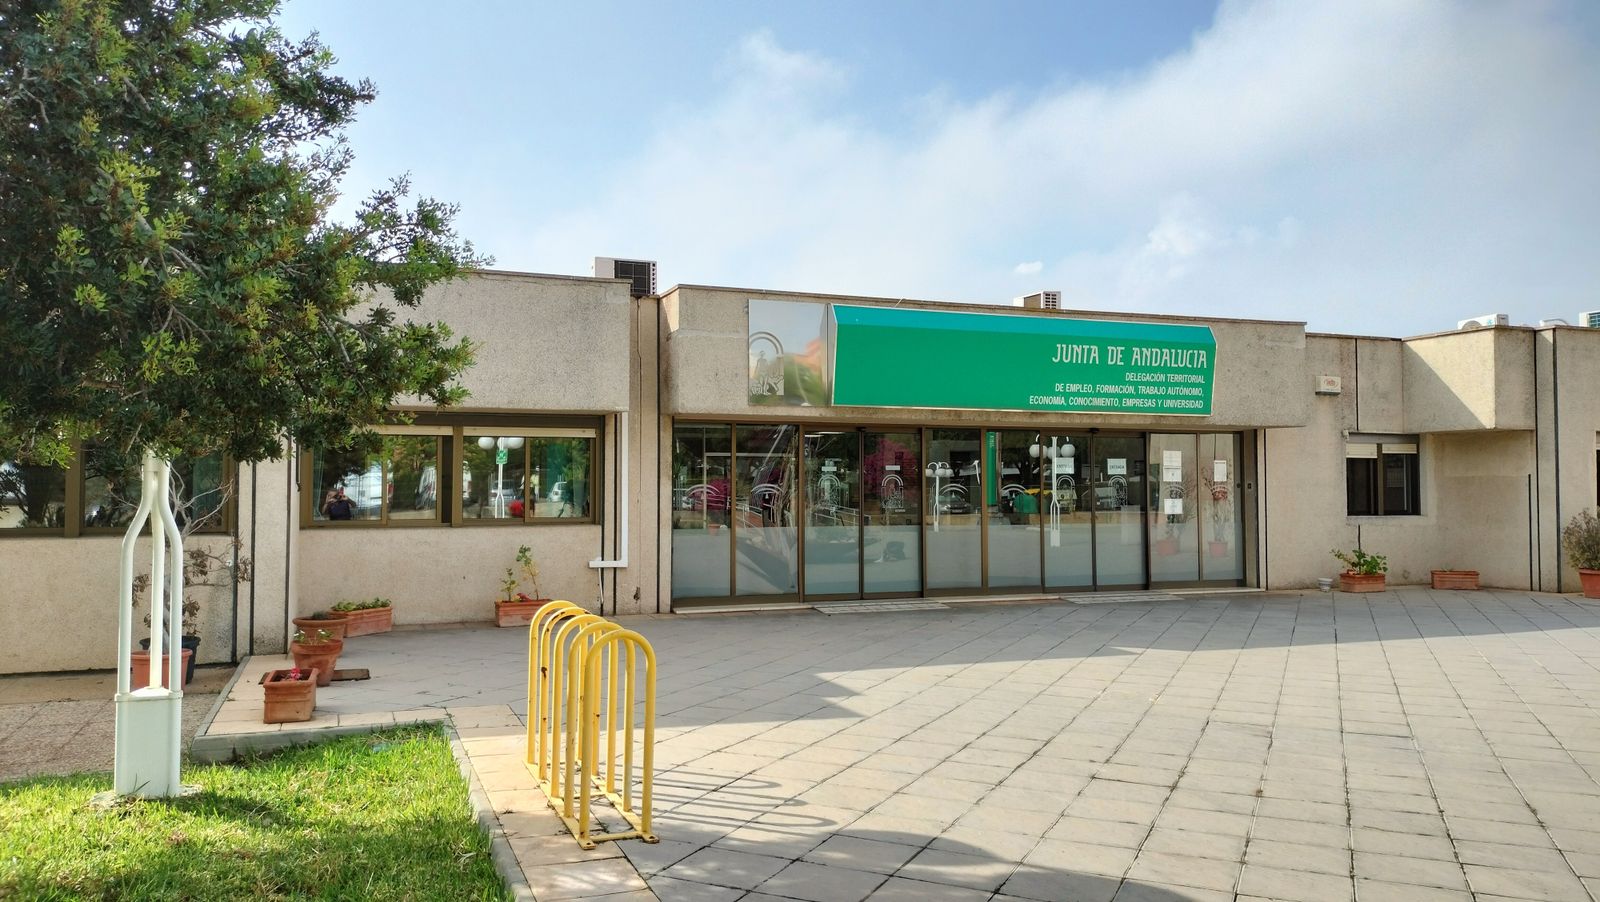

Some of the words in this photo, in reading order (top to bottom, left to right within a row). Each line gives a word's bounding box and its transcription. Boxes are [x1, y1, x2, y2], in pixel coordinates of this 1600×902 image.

[1052, 344, 1099, 364] JUNTA
[1107, 346, 1125, 366] DE
[1131, 347, 1207, 368] ANDALUCIA
[1125, 371, 1166, 382] DELEGACIÓN
[1167, 374, 1205, 384] TERRITORIAL
[1055, 383, 1065, 392] DE
[1065, 383, 1094, 394] EMPLEO,
[1096, 383, 1136, 395] FORMACIÓN,
[1138, 385, 1166, 395] TRABAJO
[1167, 385, 1204, 397] AUTÓNOMO,
[1029, 394, 1067, 406] ECONOMÍA,
[1068, 396, 1120, 408] CONOCIMIENTO,
[1122, 398, 1156, 408] EMPRESAS
[1157, 399, 1163, 408] Y
[1163, 399, 1204, 409] UNIVERSIDAD
